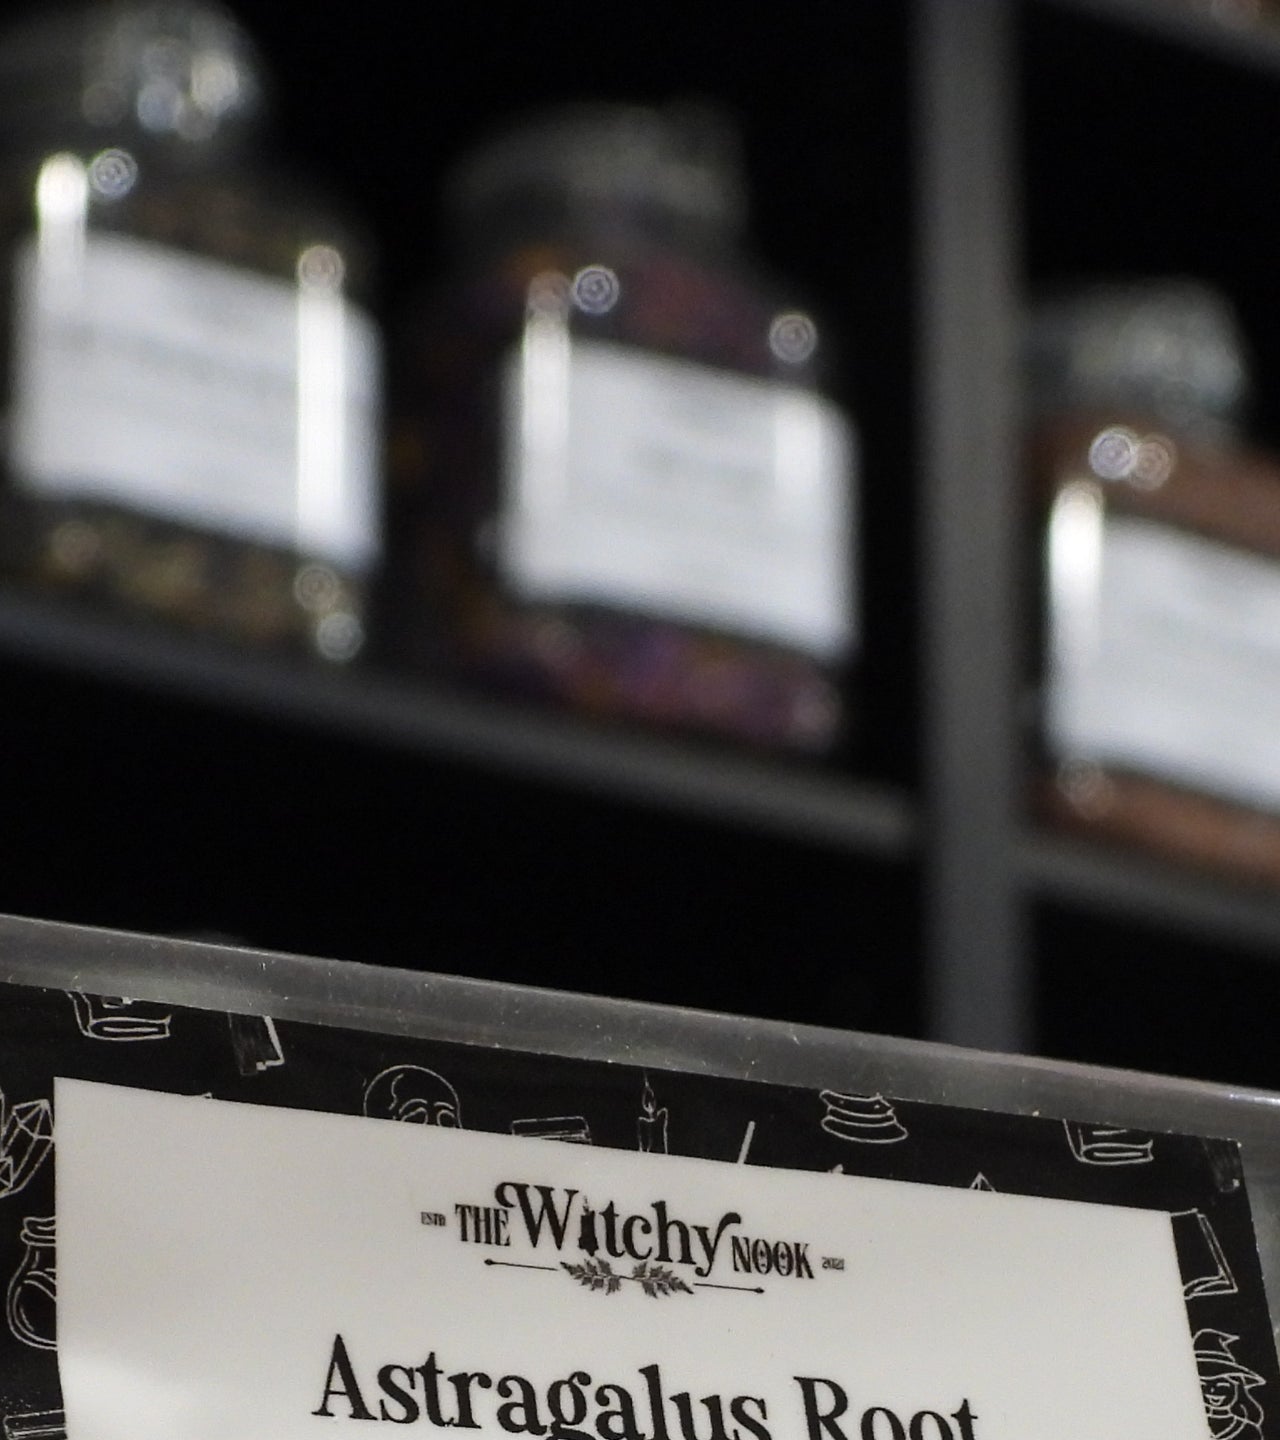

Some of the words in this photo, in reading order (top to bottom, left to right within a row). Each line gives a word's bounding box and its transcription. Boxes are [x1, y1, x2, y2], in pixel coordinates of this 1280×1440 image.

[454, 1203, 511, 1247] THE
[494, 1181, 742, 1278] Witchy
[730, 1234, 815, 1280] NOOK
